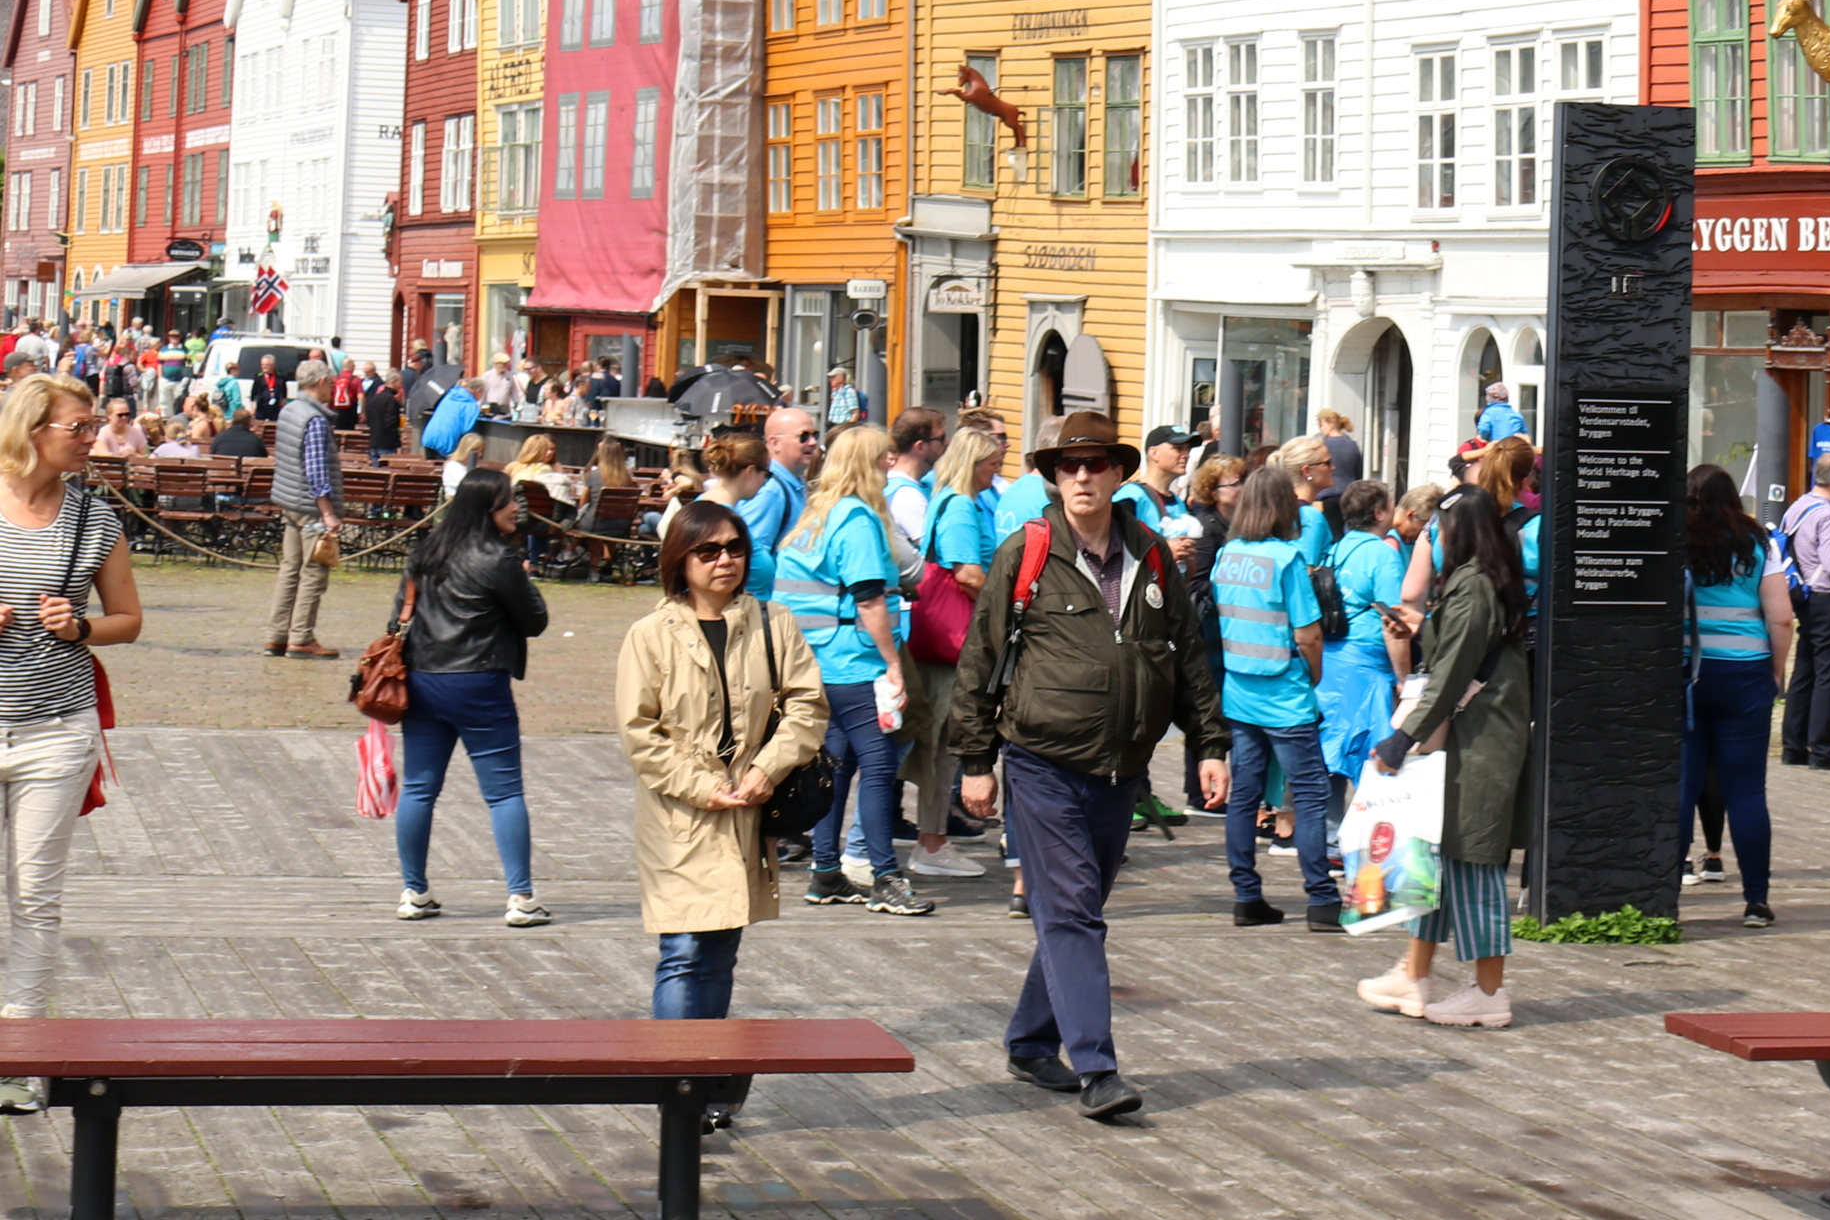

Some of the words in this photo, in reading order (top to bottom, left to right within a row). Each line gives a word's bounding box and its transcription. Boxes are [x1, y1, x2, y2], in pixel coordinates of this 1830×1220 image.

[489, 59, 532, 99] ALFRED
[1024, 244, 1097, 271] SJØBODEN
[933, 292, 946, 306] To
[947, 292, 982, 307] Kokker
[1579, 405, 1627, 414] Velkommen
[1629, 406, 1638, 414] til
[1579, 428, 1612, 438] Bryggen
[1578, 455, 1615, 464] Welcome
[1629, 456, 1643, 464] the
[1578, 467, 1602, 476] World
[1605, 468, 1640, 478] Heritage
[1642, 468, 1659, 478] site,
[1577, 479, 1611, 489] Bryggen
[1577, 505, 1617, 515] Bienvenue
[1628, 506, 1663, 517] Bryggen,
[1576, 517, 1592, 526] Site
[1594, 518, 1605, 526] du
[1607, 518, 1651, 527] Patrimoine
[1576, 529, 1610, 538] Mondial
[1575, 556, 1624, 565] Willkommen
[1215, 555, 1268, 584] delta
[1575, 580, 1608, 590] Bryggen
